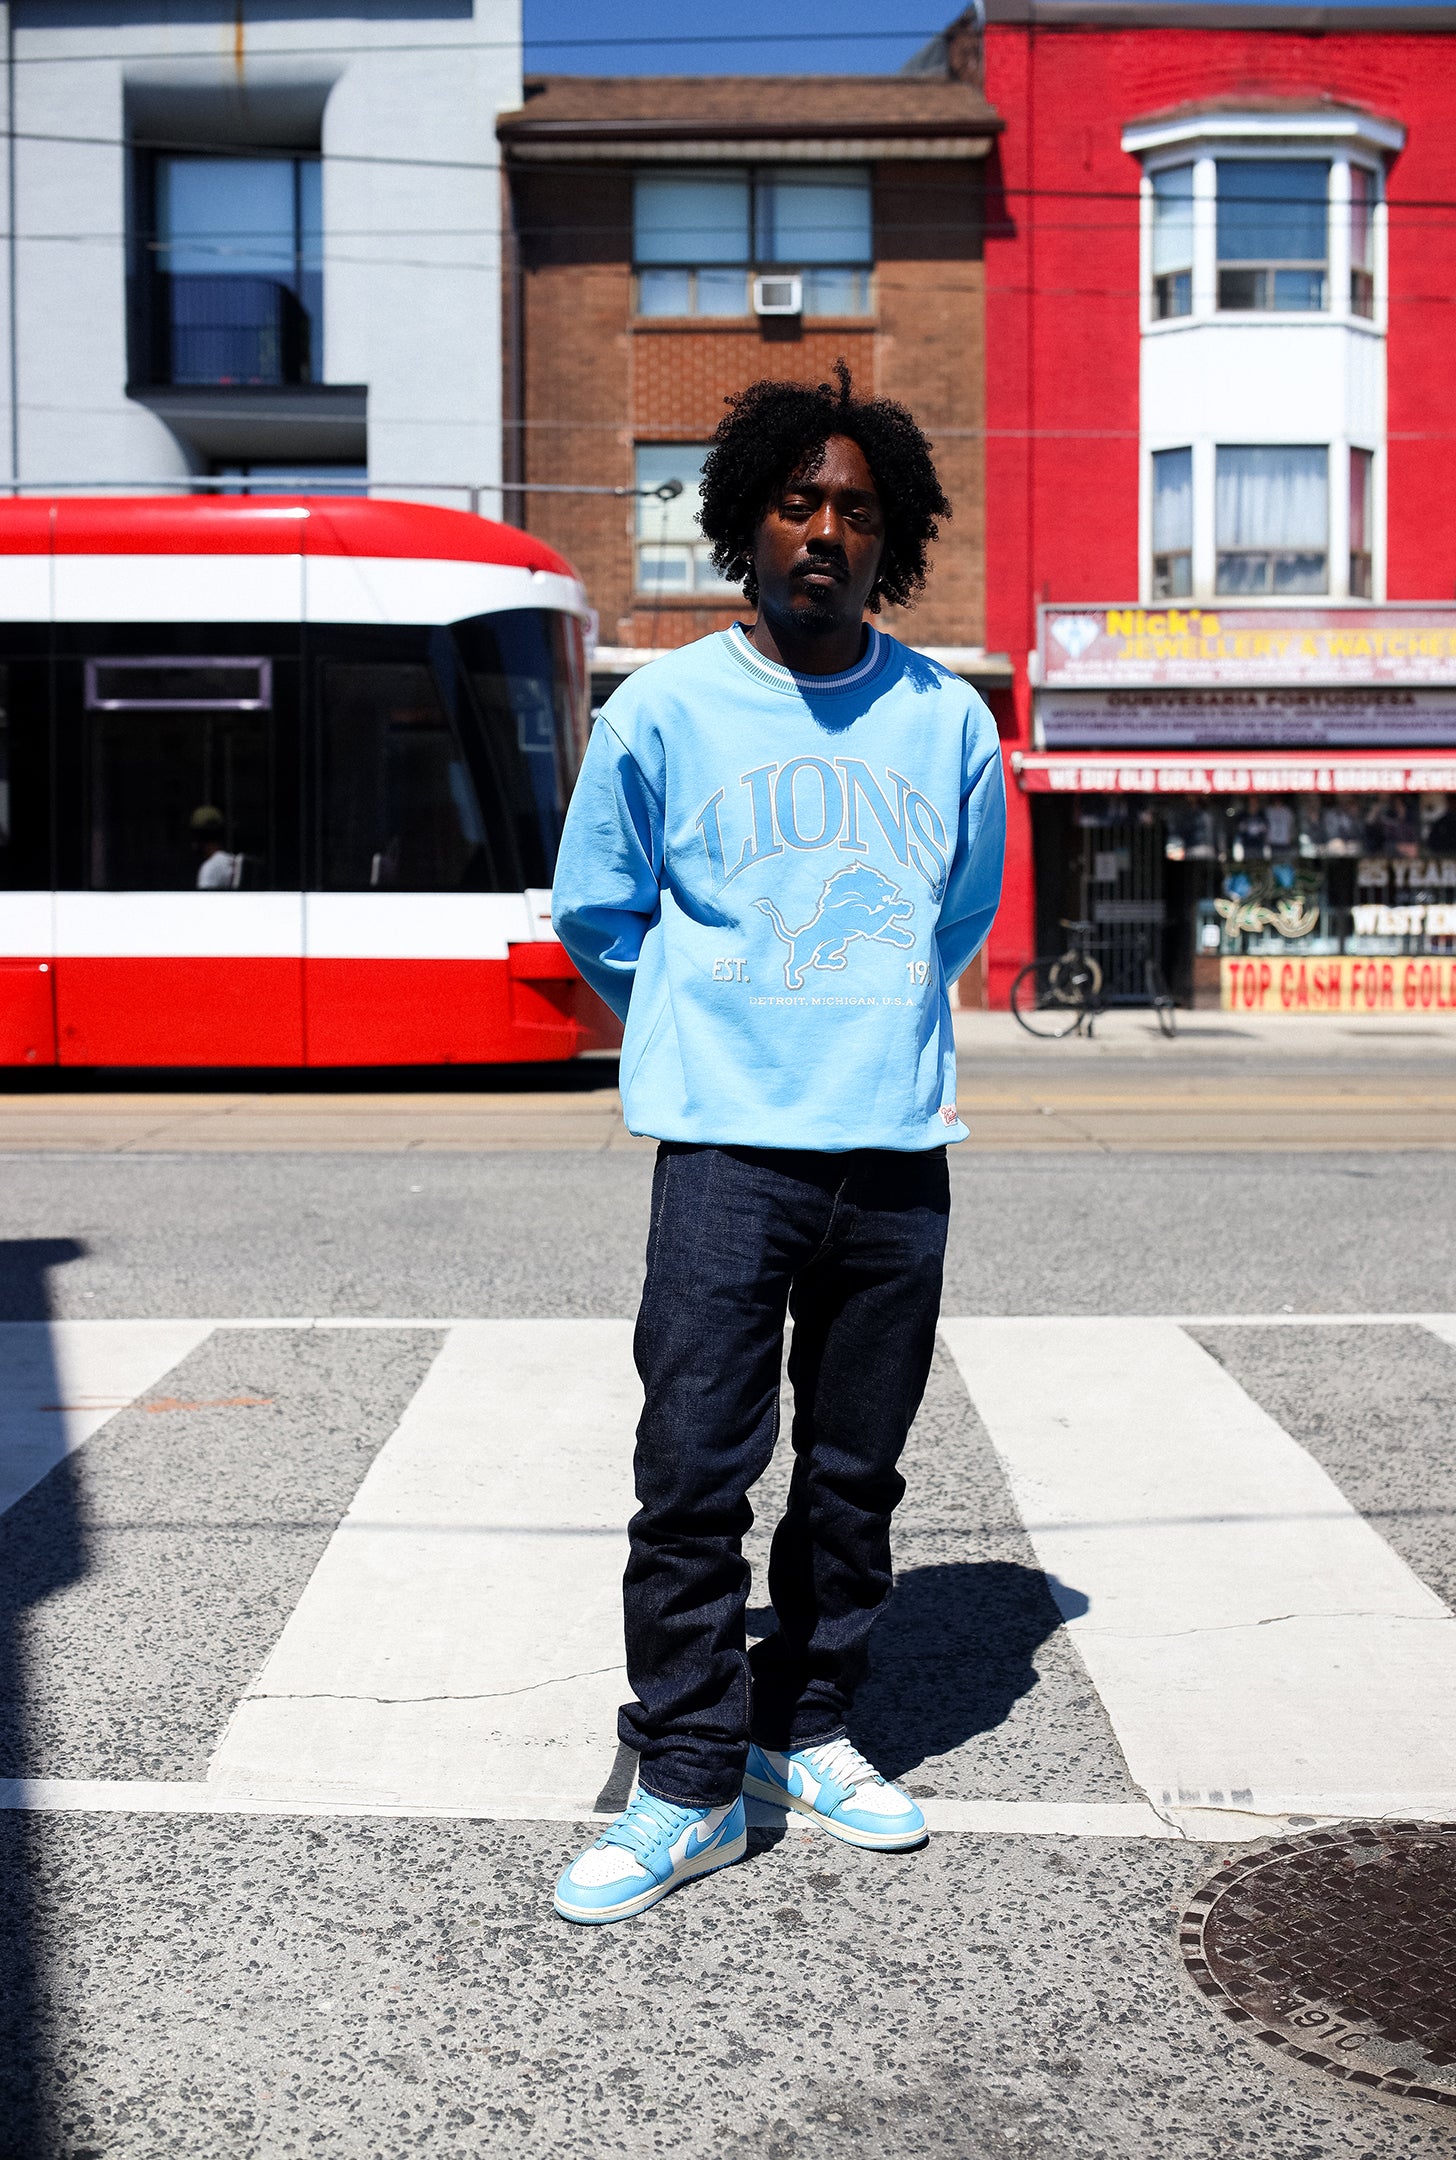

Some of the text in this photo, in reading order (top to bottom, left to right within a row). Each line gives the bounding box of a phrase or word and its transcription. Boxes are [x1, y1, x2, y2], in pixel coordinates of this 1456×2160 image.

[1106, 609, 1220, 637] Nick's
[1118, 636, 1288, 660] JEWELLERY
[1081, 769, 1116, 790] BUY
[1119, 769, 1154, 790] OLD
[1213, 769, 1249, 791] OLD
[695, 755, 948, 901] LIONS
[1350, 904, 1425, 936] WEST
[712, 957, 750, 982] EST.
[1229, 963, 1272, 1008] TOP
[1280, 963, 1342, 1008] CASH
[1351, 963, 1395, 1008] FOR
[749, 996, 918, 1007] DETROIT, MICHIGAN, U.S.A.
